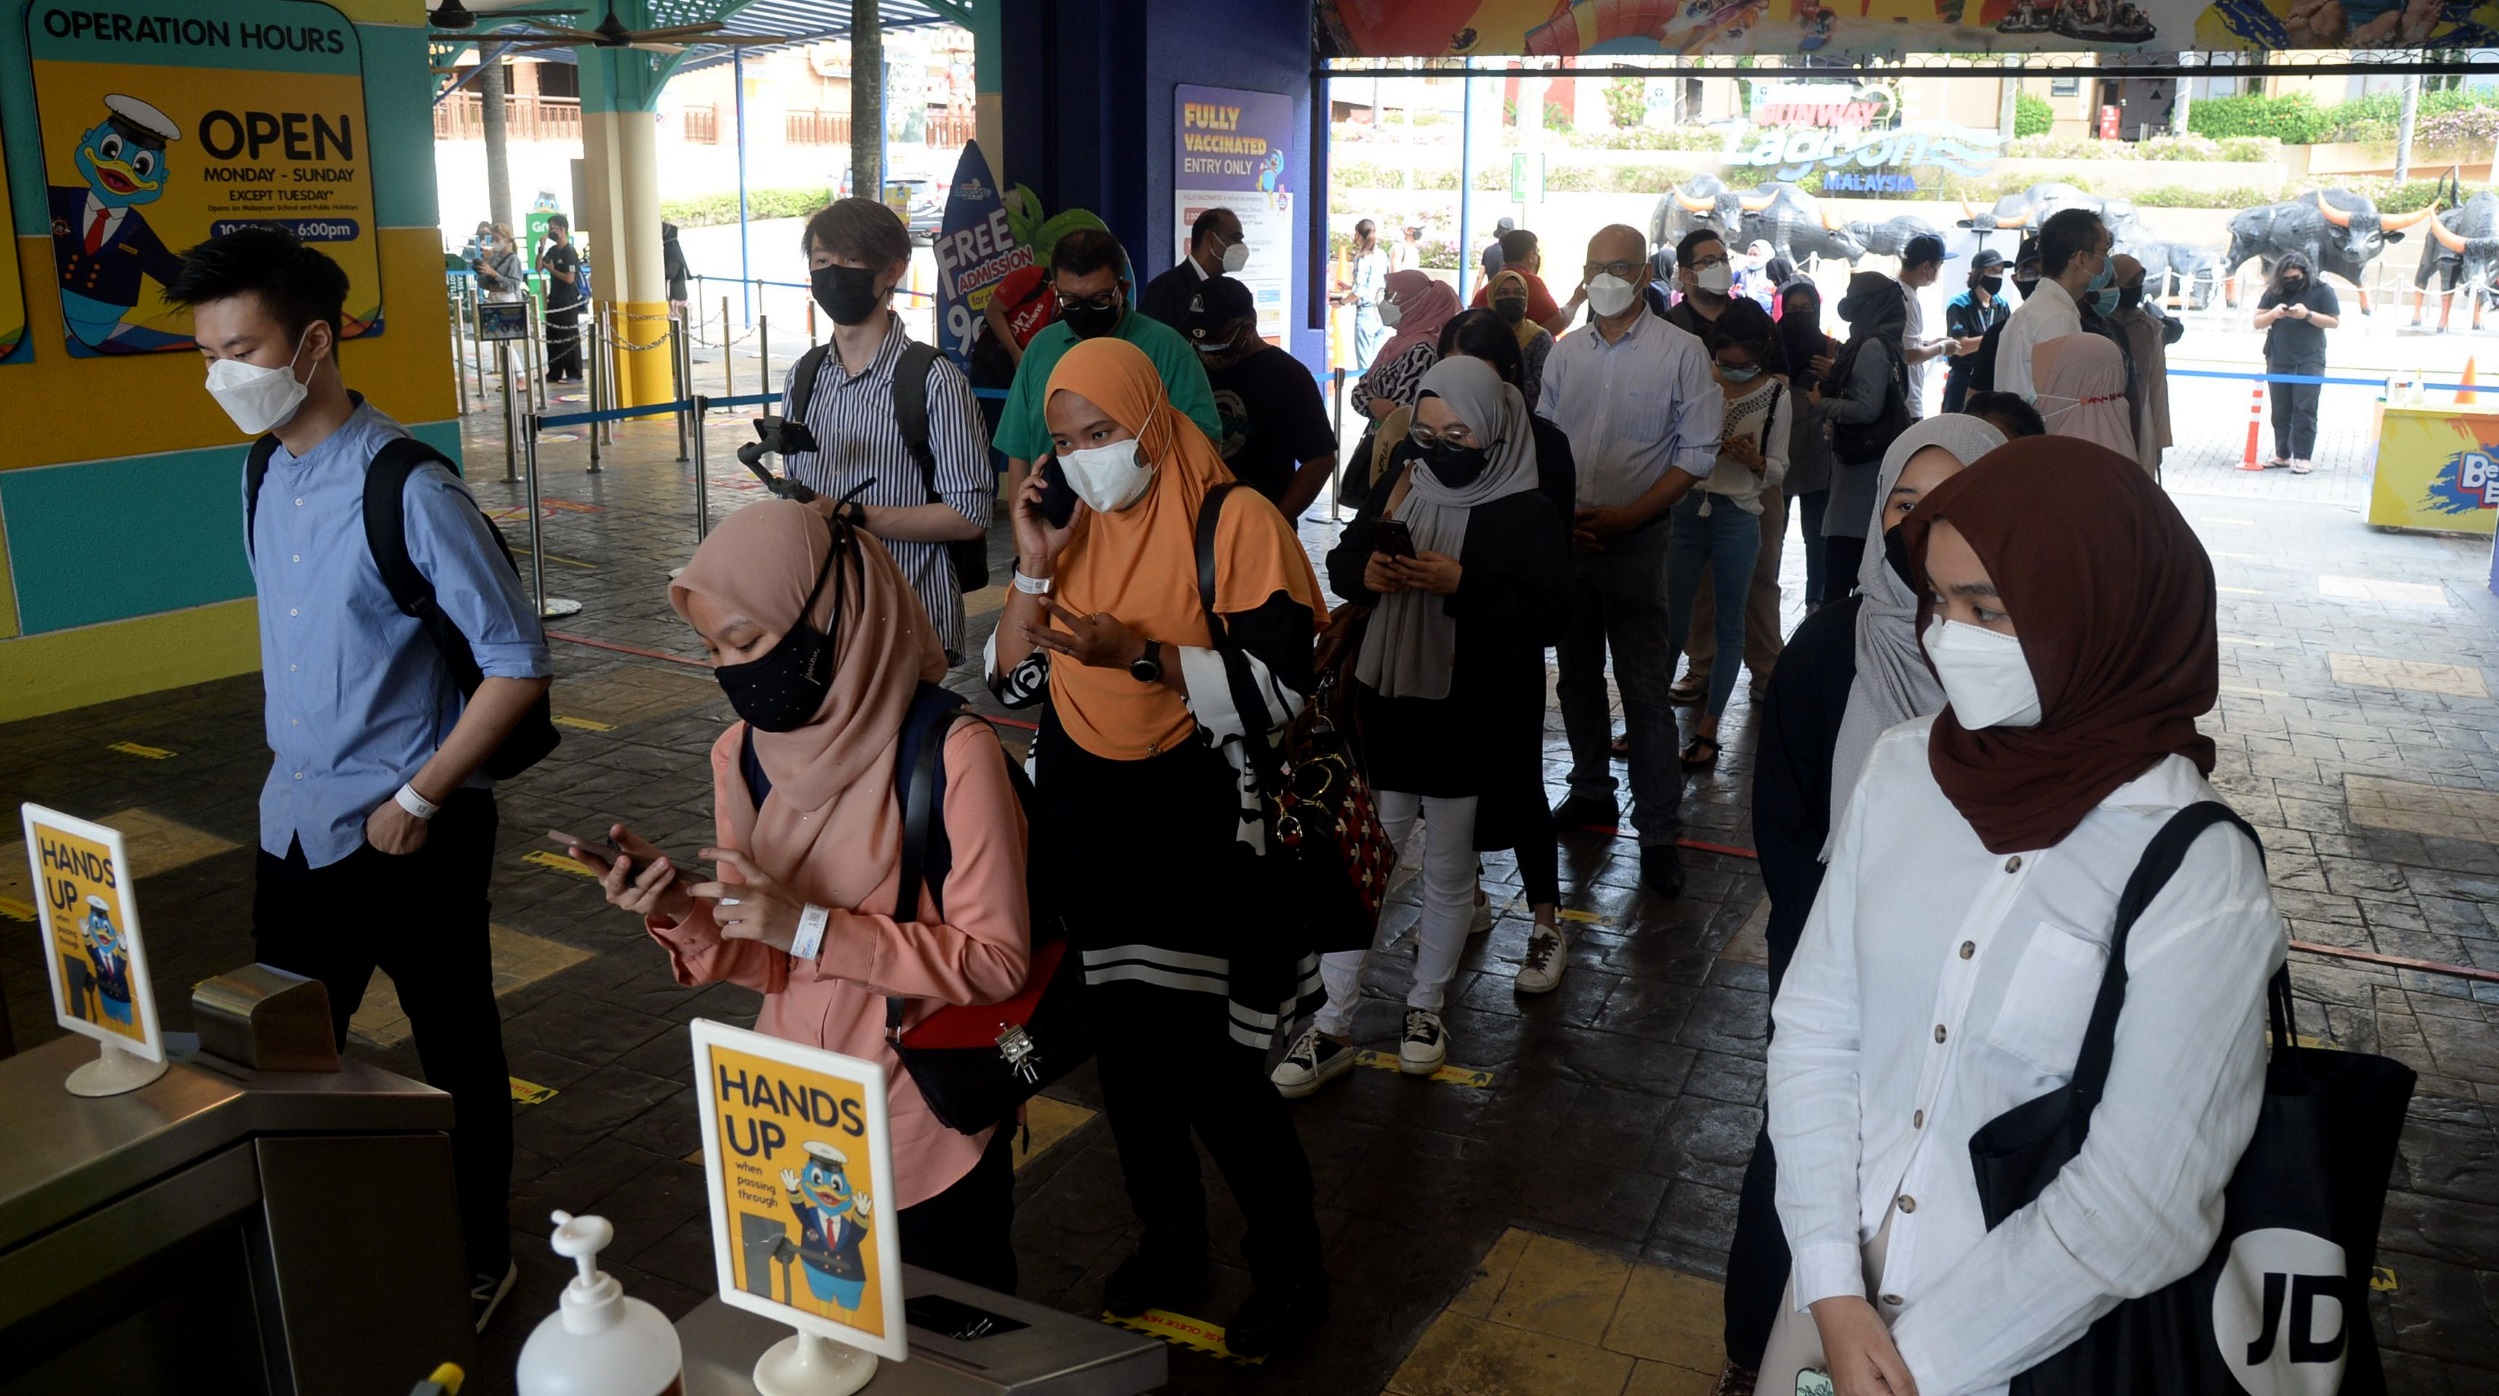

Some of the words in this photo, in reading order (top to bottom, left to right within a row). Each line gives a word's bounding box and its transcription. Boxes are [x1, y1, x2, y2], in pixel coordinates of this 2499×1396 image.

[44, 9, 231, 48] OPERATION
[241, 25, 344, 54] HOURS
[1184, 103, 1240, 131] FULLY
[1759, 102, 1882, 127] SUNWAY
[199, 109, 353, 161] OPEN
[1184, 133, 1267, 156] VACCINATED
[204, 167, 276, 182] MONDAY
[293, 168, 355, 183] SUNDAY
[1184, 158, 1221, 174] ENTRY
[1224, 159, 1253, 175] ONLY
[1823, 173, 1917, 192] MALAYSIA
[229, 190, 272, 201] EXCEPT
[298, 223, 350, 239] 6:00pm
[934, 208, 1014, 301] FREE
[957, 245, 1035, 294] ADMISSION
[40, 837, 116, 889] HANDS
[47, 877, 78, 912] UP
[719, 1064, 865, 1137] HANDS
[725, 1114, 786, 1161] UP
[735, 1161, 763, 1175] when
[737, 1175, 776, 1196] passing
[738, 1189, 779, 1208] through
[1166, 1320, 1201, 1335] QUEUE
[2247, 1272, 2348, 1366] JD
